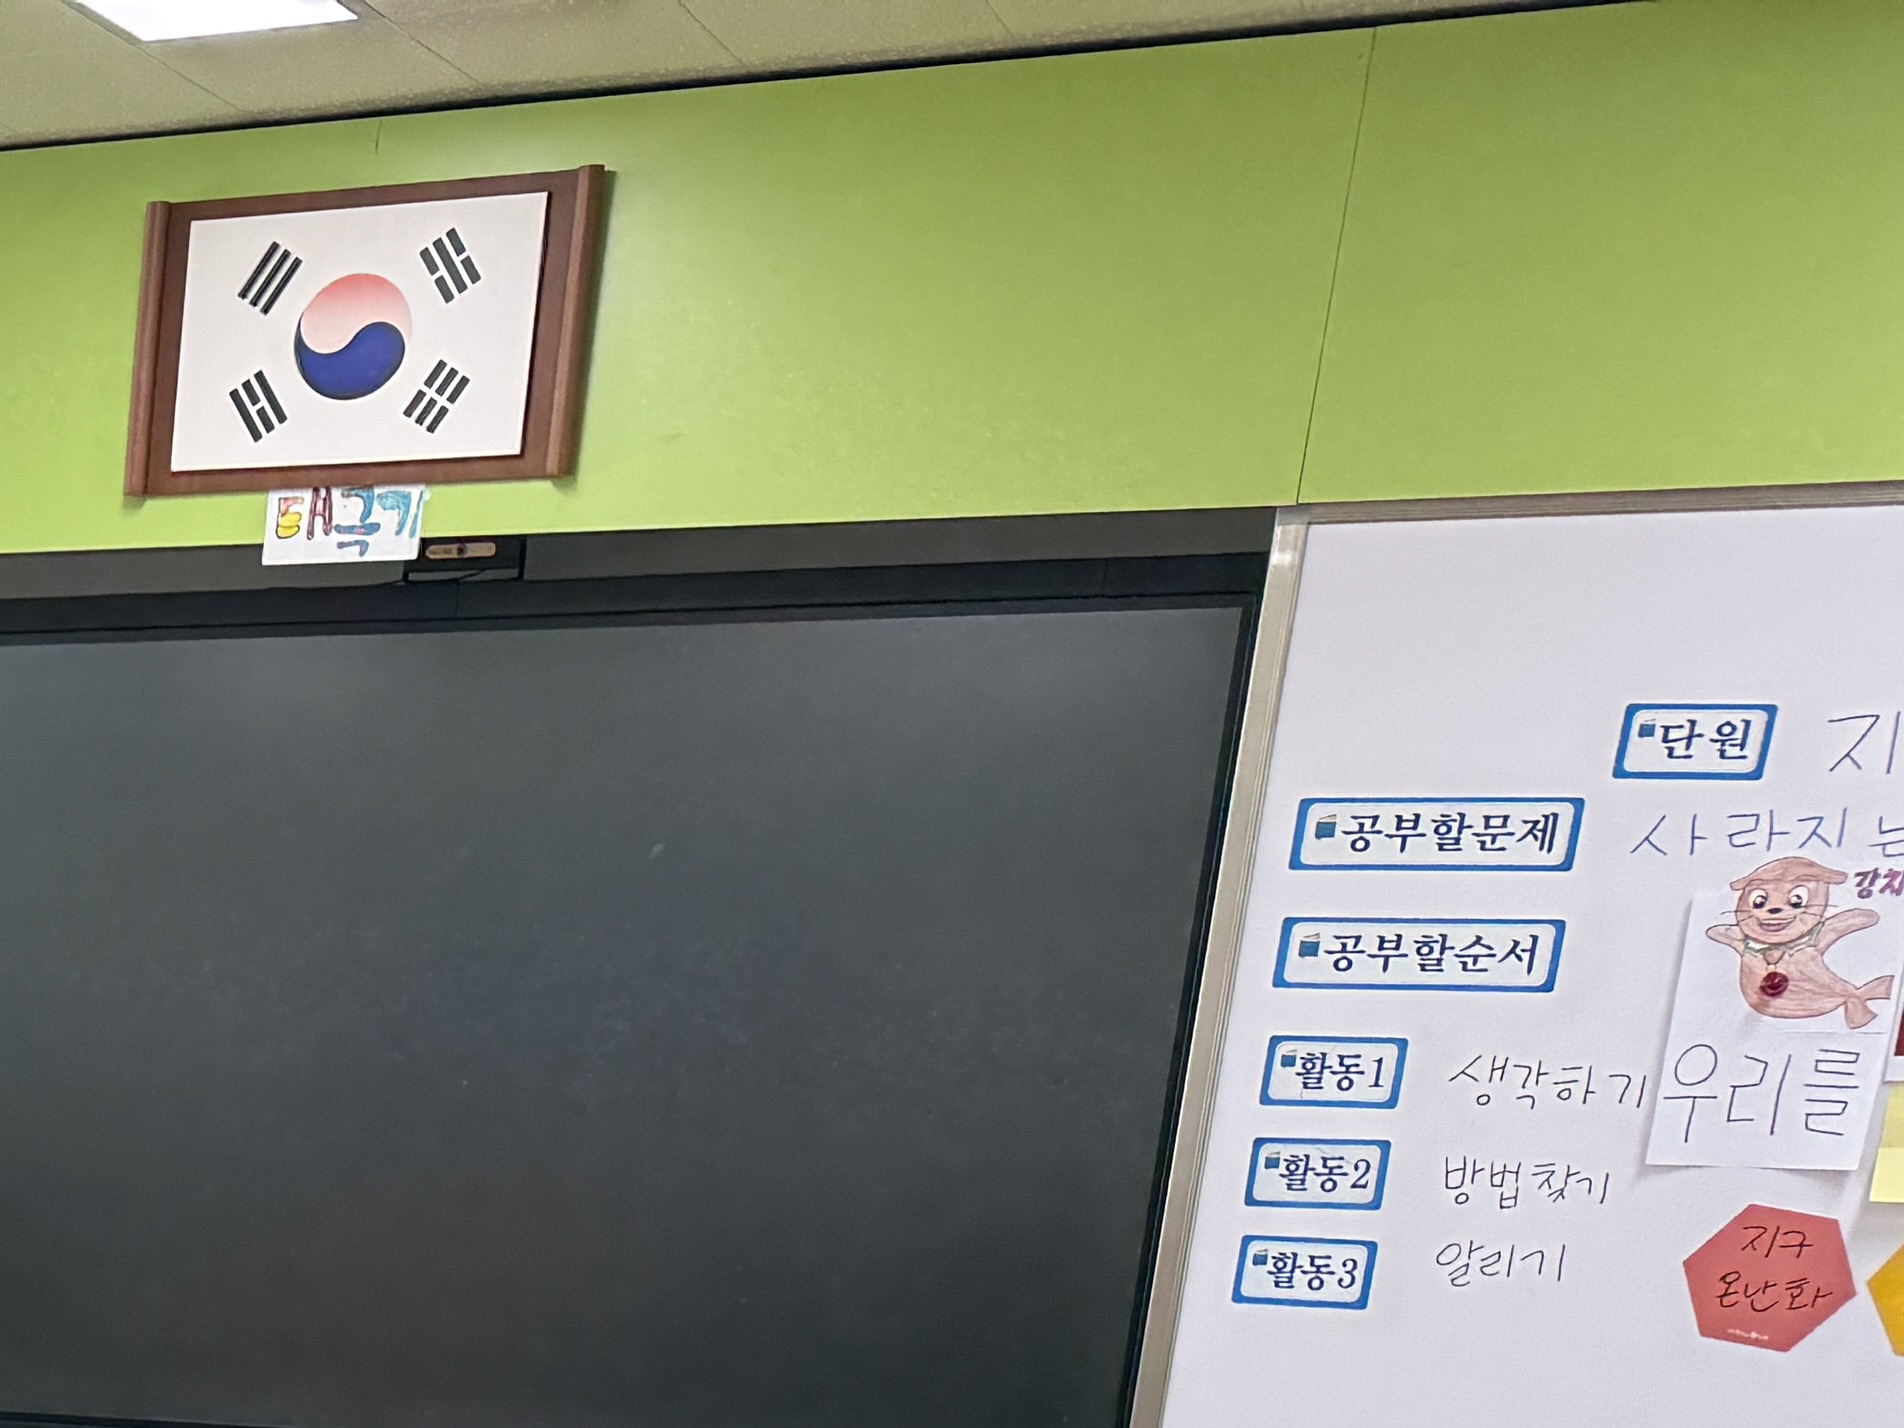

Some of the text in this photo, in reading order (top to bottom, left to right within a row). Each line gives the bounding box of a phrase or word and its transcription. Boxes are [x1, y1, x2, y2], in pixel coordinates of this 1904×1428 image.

[276, 486, 424, 558] 태극기
[1659, 718, 1753, 760] 단원
[1342, 813, 1560, 856] 공부할문제
[1324, 931, 1537, 974] 공부할순서
[1295, 1051, 1386, 1094] 활동1
[1449, 1053, 1647, 1111] 생각하기
[1663, 1044, 1862, 1142] 우리를
[1278, 1154, 1371, 1192] 활동2
[1741, 1225, 1814, 1259] 지구
[1266, 1252, 1359, 1291] 활동3
[1435, 1241, 1567, 1287] 알리기
[1715, 1271, 1833, 1312] 온난화
